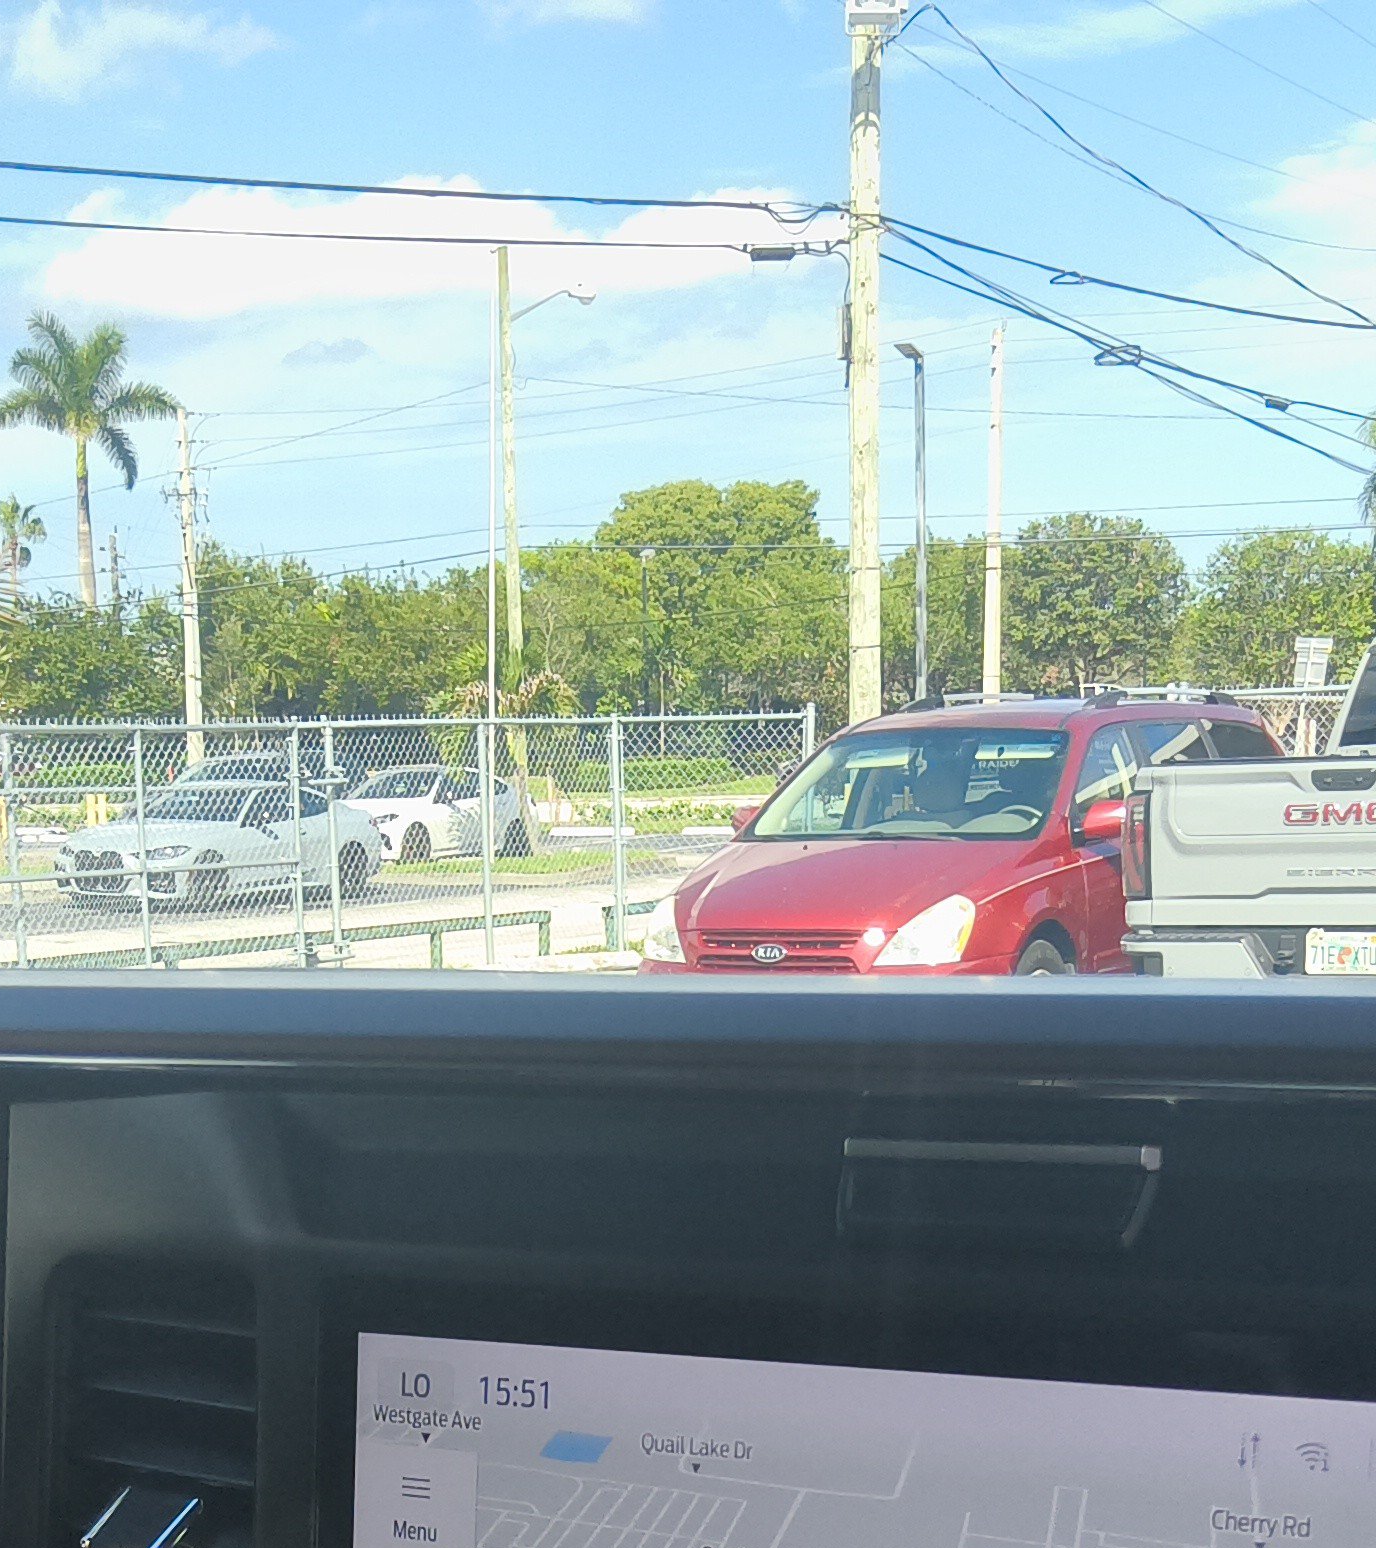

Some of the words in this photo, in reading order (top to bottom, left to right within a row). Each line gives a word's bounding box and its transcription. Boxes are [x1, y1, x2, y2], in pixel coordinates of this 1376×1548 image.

[757, 947, 780, 958] KIA
[400, 1372, 431, 1398] LO
[477, 1374, 552, 1411] 15:51
[372, 1404, 448, 1432] Westgate
[450, 1411, 483, 1431] Ave
[640, 1433, 686, 1457] Quail
[689, 1436, 729, 1458] Lake
[732, 1440, 754, 1460] Dr
[392, 1520, 438, 1543] Menu
[1211, 1509, 1277, 1538] Cherry
[1282, 1516, 1312, 1538] Rd
